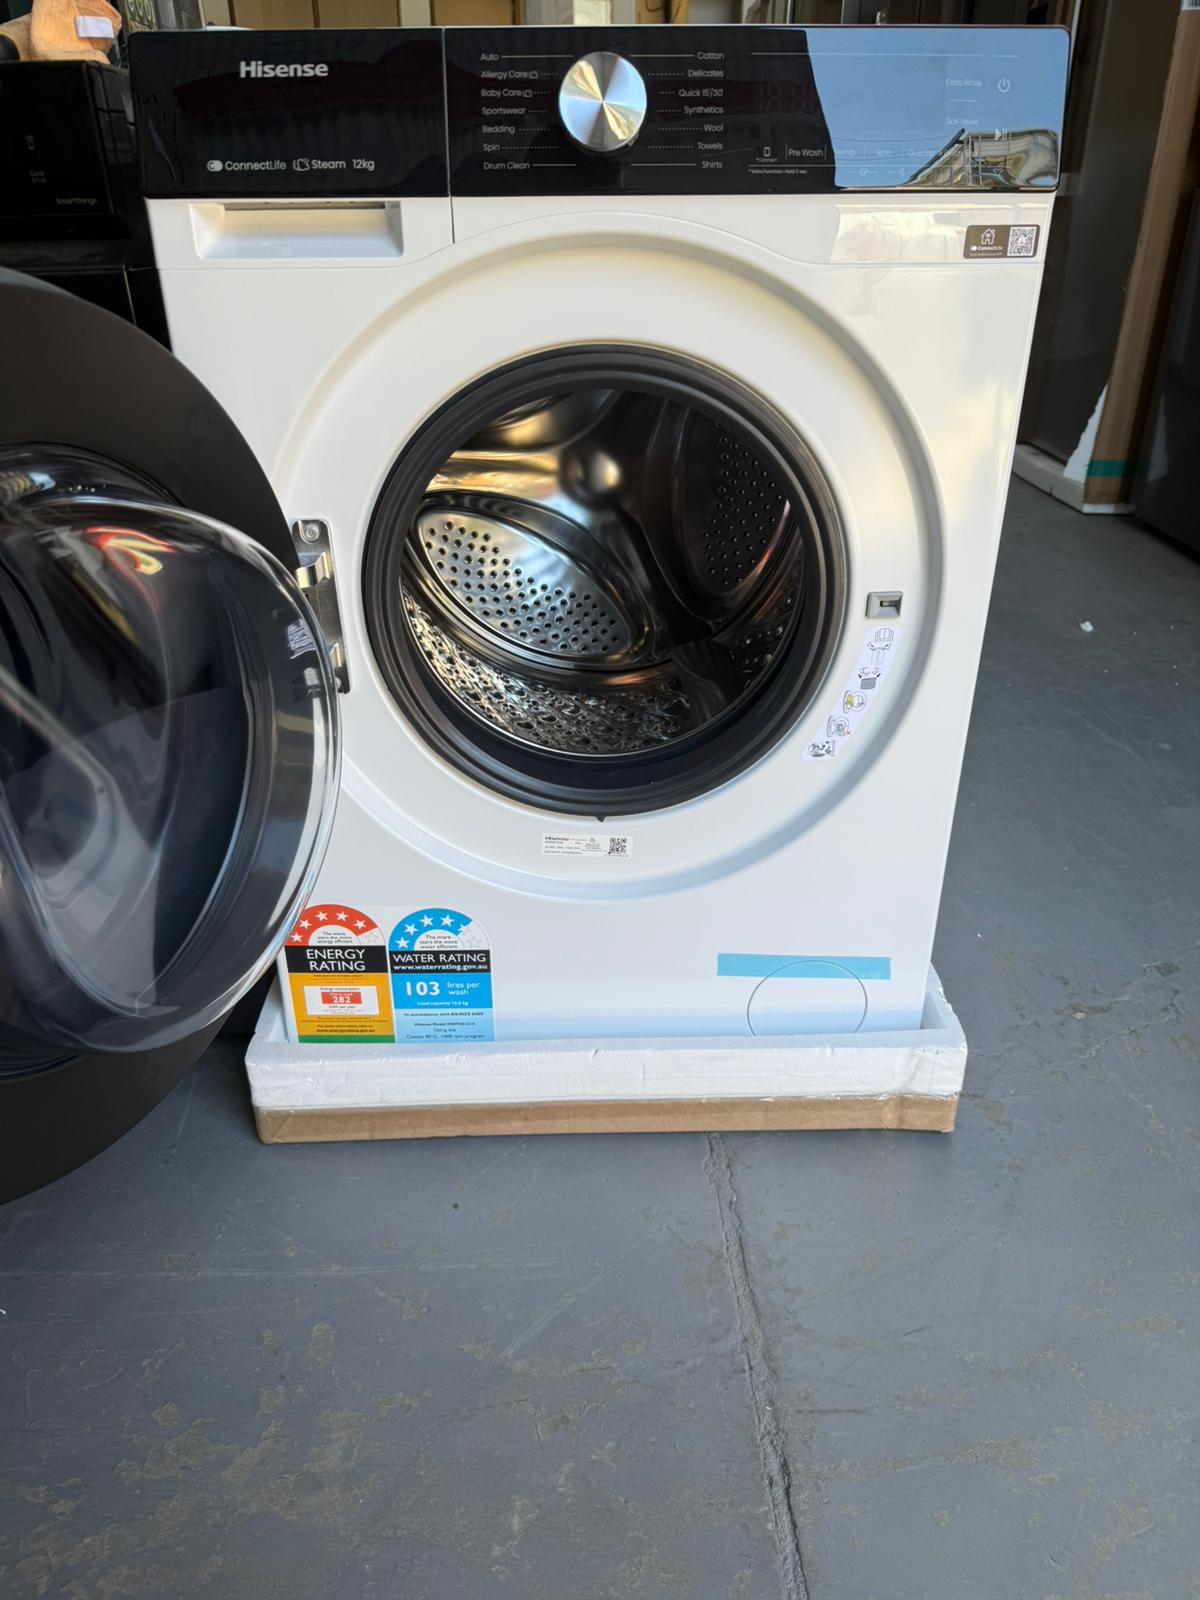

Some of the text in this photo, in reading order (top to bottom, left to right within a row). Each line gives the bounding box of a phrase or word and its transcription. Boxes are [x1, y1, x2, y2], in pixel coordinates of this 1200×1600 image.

[480, 53, 499, 61] Auto
[698, 52, 724, 60] Cotton
[240, 60, 329, 78] Hisense
[688, 69, 724, 78] Delicates
[481, 71, 508, 80] Allergy
[481, 89, 501, 98] Baby
[678, 89, 700, 98] Quick
[482, 107, 526, 116] Sportswear
[684, 106, 724, 115] Synthetics
[482, 125, 515, 134] Bedding
[704, 124, 724, 132] Wool
[483, 143, 500, 152] Spin
[697, 142, 723, 150] Towels
[788, 148, 823, 157] Pre Wash
[224, 160, 287, 171] ConnectLife
[311, 159, 346, 169] Steam
[352, 159, 375, 171] 12kg
[484, 161, 530, 169] Drum Clean
[702, 161, 723, 169] Shirts
[306, 949, 366, 960] ENERGY
[393, 953, 486, 964] WATER RATING
[310, 961, 366, 971] RATING
[405, 981, 440, 996] 103
